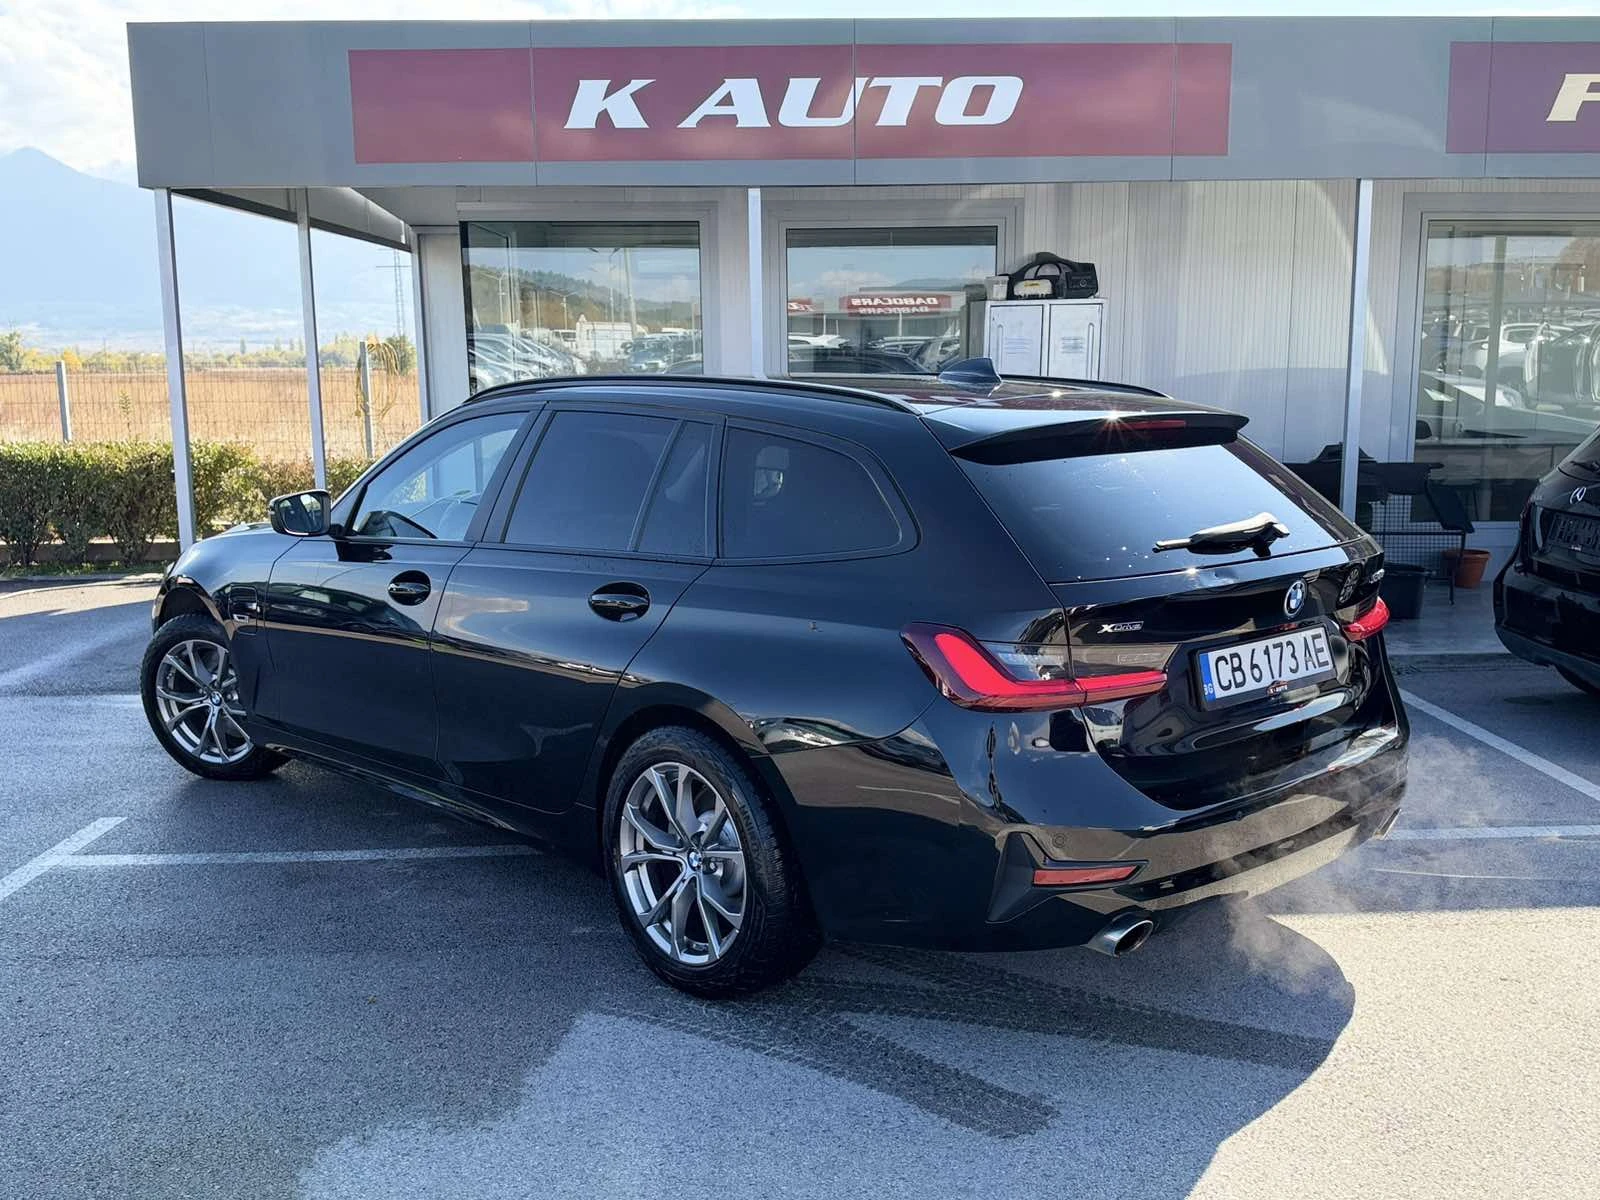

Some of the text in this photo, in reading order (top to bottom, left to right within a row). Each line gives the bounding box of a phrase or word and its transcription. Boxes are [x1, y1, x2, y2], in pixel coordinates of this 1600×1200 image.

[564, 76, 1023, 129] K AUTO
[1215, 632, 1329, 692] CB 6173 AE
